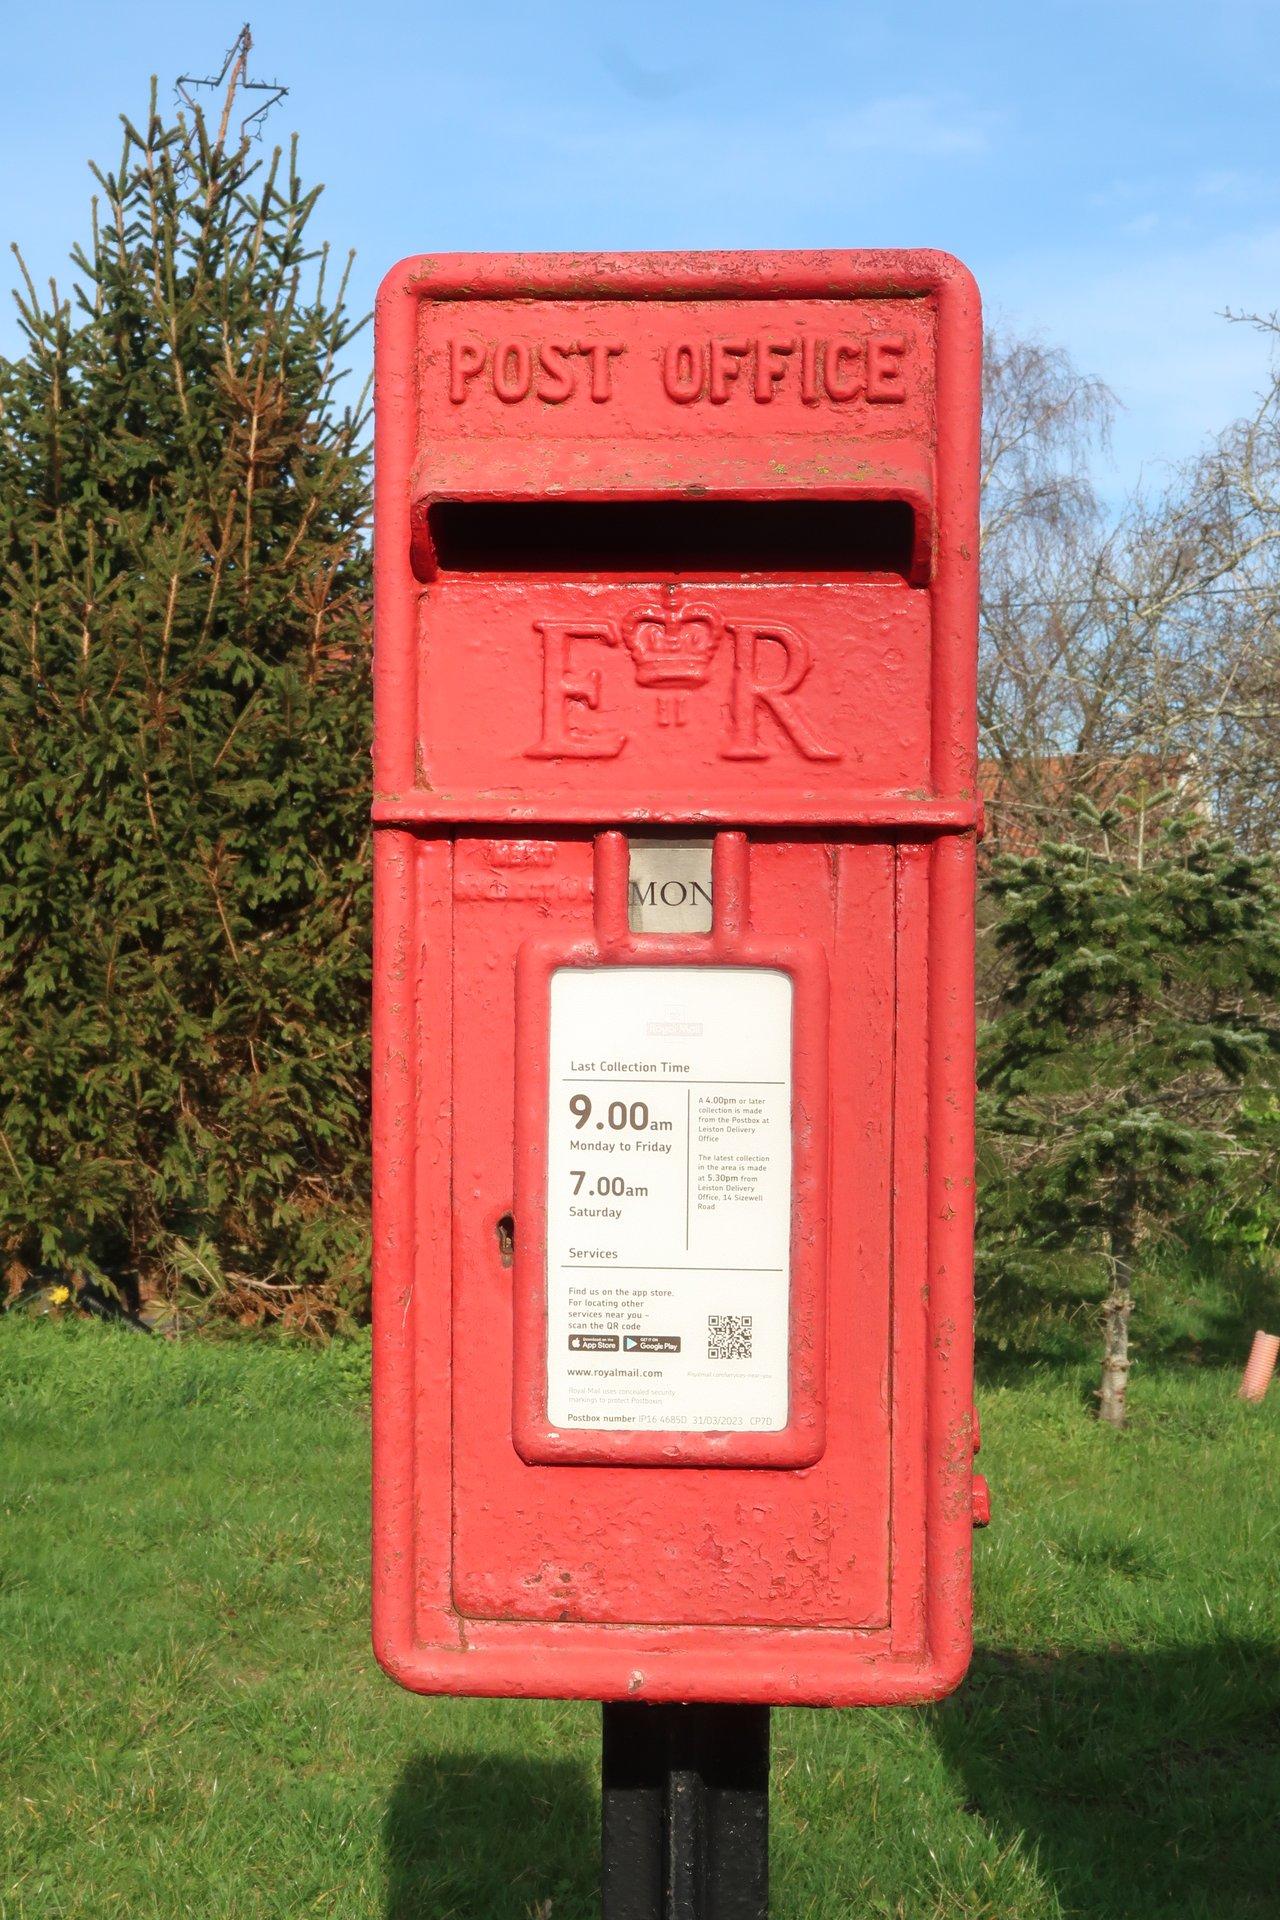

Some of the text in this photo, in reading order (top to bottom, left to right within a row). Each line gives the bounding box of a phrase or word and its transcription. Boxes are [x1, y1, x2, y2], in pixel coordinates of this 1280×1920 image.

[448, 334, 907, 405] POST OFFICE
[523, 617, 843, 761] E R
[629, 880, 713, 907] MON
[570, 1061, 691, 1073] Last Collection Time
[705, 1096, 737, 1106] 4.00pm
[569, 1094, 672, 1131] 9.00am
[726, 1126, 756, 1135] Delivery
[698, 1135, 720, 1143] Office
[570, 1140, 672, 1154] Monday to Friday
[569, 1170, 649, 1197] 7.00am
[707, 1174, 739, 1183] 5.30pm
[725, 1184, 756, 1193] Delivery
[734, 1194, 764, 1202] Sizewell
[569, 1206, 622, 1219] Saturday
[569, 1248, 618, 1259] Services
[568, 1287, 588, 1295] Find
[602, 1288, 613, 1296] on
[615, 1288, 630, 1296] the
[632, 1290, 648, 1298] app
[650, 1289, 675, 1297] store.
[568, 1298, 644, 1309] For locating other
[568, 1310, 603, 1318] services
[605, 1311, 625, 1319] near
[627, 1312, 643, 1320] you
[568, 1322, 641, 1331] scan the QR code
[583, 1342, 597, 1350] App
[640, 1343, 678, 1351] Google Play
[567, 1368, 663, 1378] www.royalmail.com
[567, 1414, 601, 1422] Postbox
[603, 1415, 636, 1423] number
